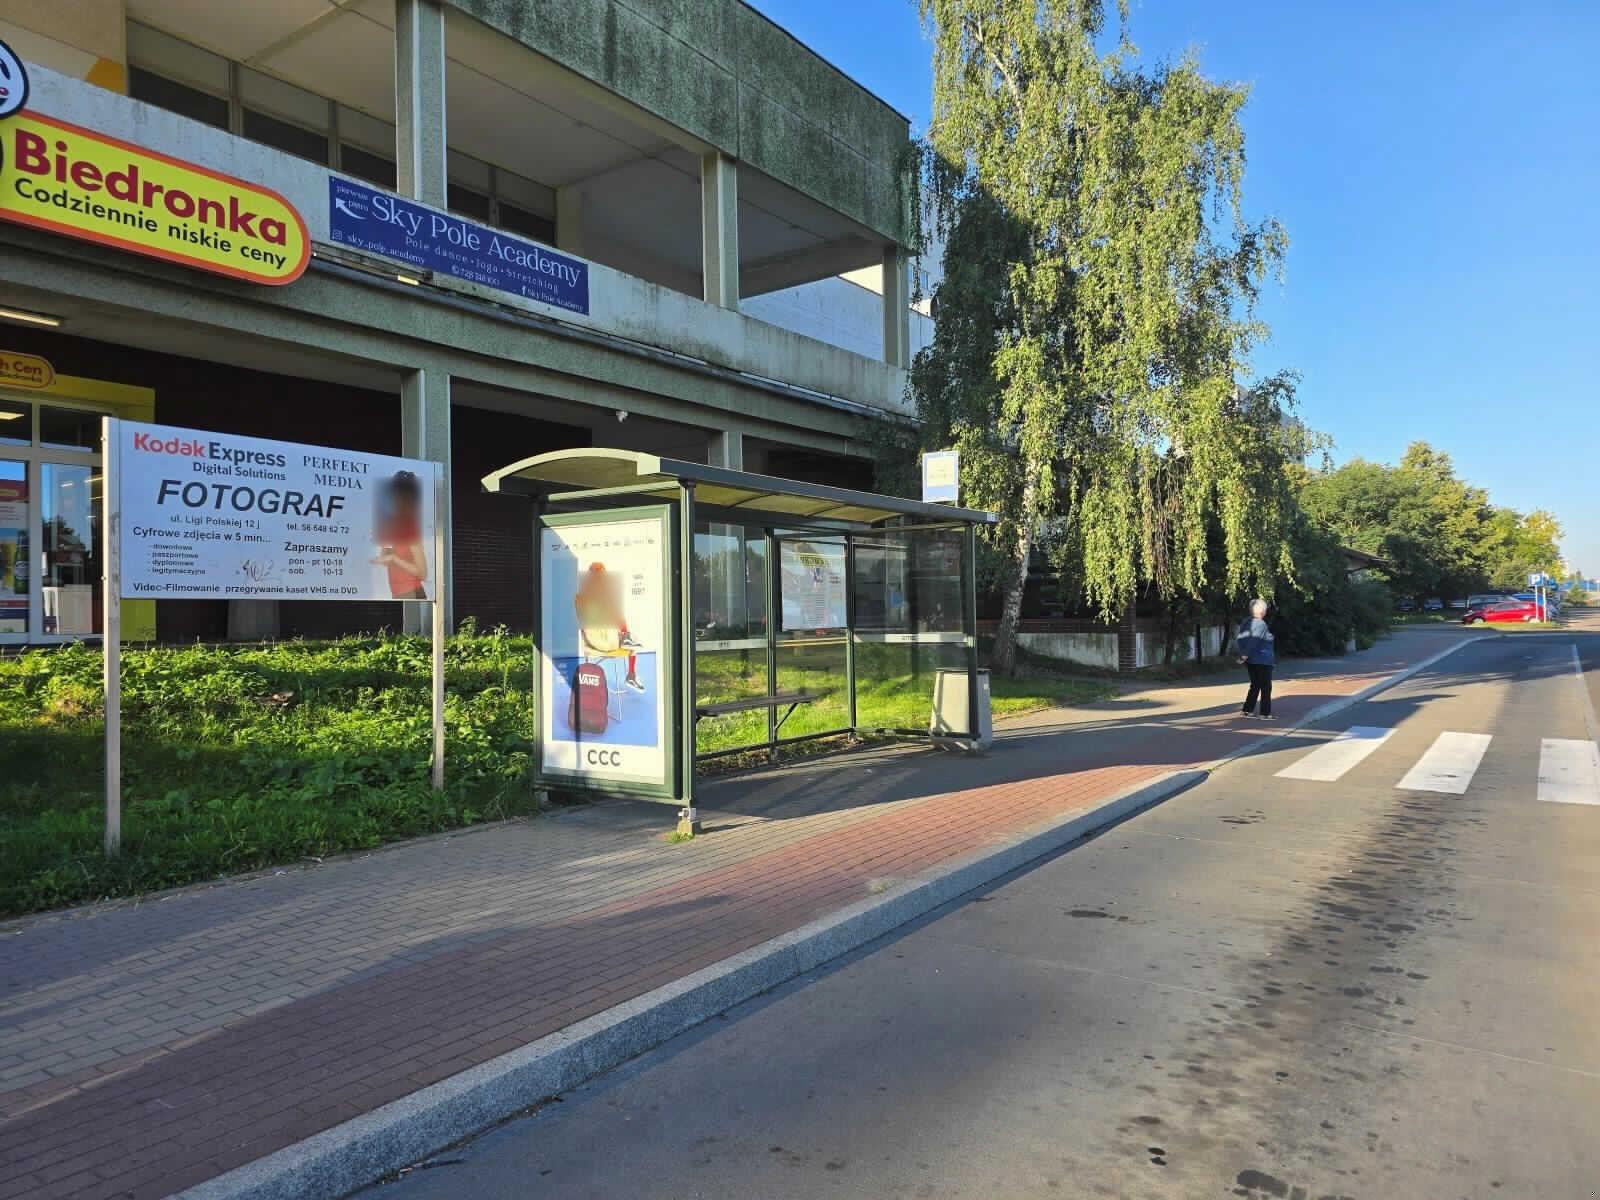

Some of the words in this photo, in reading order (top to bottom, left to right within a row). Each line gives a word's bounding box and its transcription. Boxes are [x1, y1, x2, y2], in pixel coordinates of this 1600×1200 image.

[16, 128, 286, 246] Biedronka
[15, 178, 158, 232] Codziennie
[168, 223, 231, 252] niskie
[240, 245, 286, 269] ceny
[372, 196, 424, 236] Sky
[430, 215, 480, 251] Pole
[488, 236, 581, 288] Academy
[406, 236, 431, 250] Pole
[435, 246, 470, 263] dance
[134, 432, 206, 458] Kodak
[208, 441, 287, 467] Express
[193, 462, 232, 476] Digital
[235, 466, 287, 481] Solutions
[303, 455, 369, 474] PERFEKT
[314, 473, 363, 490] MEDIA
[157, 479, 345, 518] FOTOGRAF
[170, 513, 183, 523] ul.
[185, 514, 203, 526] Ligi
[205, 516, 242, 529] Polskiej
[245, 519, 255, 528] 12
[132, 526, 180, 538] Cyfrowe
[183, 529, 221, 541] zdjęcia
[235, 532, 242, 541] 5
[283, 541, 349, 556] Zapraszamy
[225, 585, 284, 595] przegrywanie
[286, 586, 308, 594] kaset
[340, 586, 358, 594] DVD
[578, 673, 601, 687] VANS
[587, 749, 621, 767] CCC
